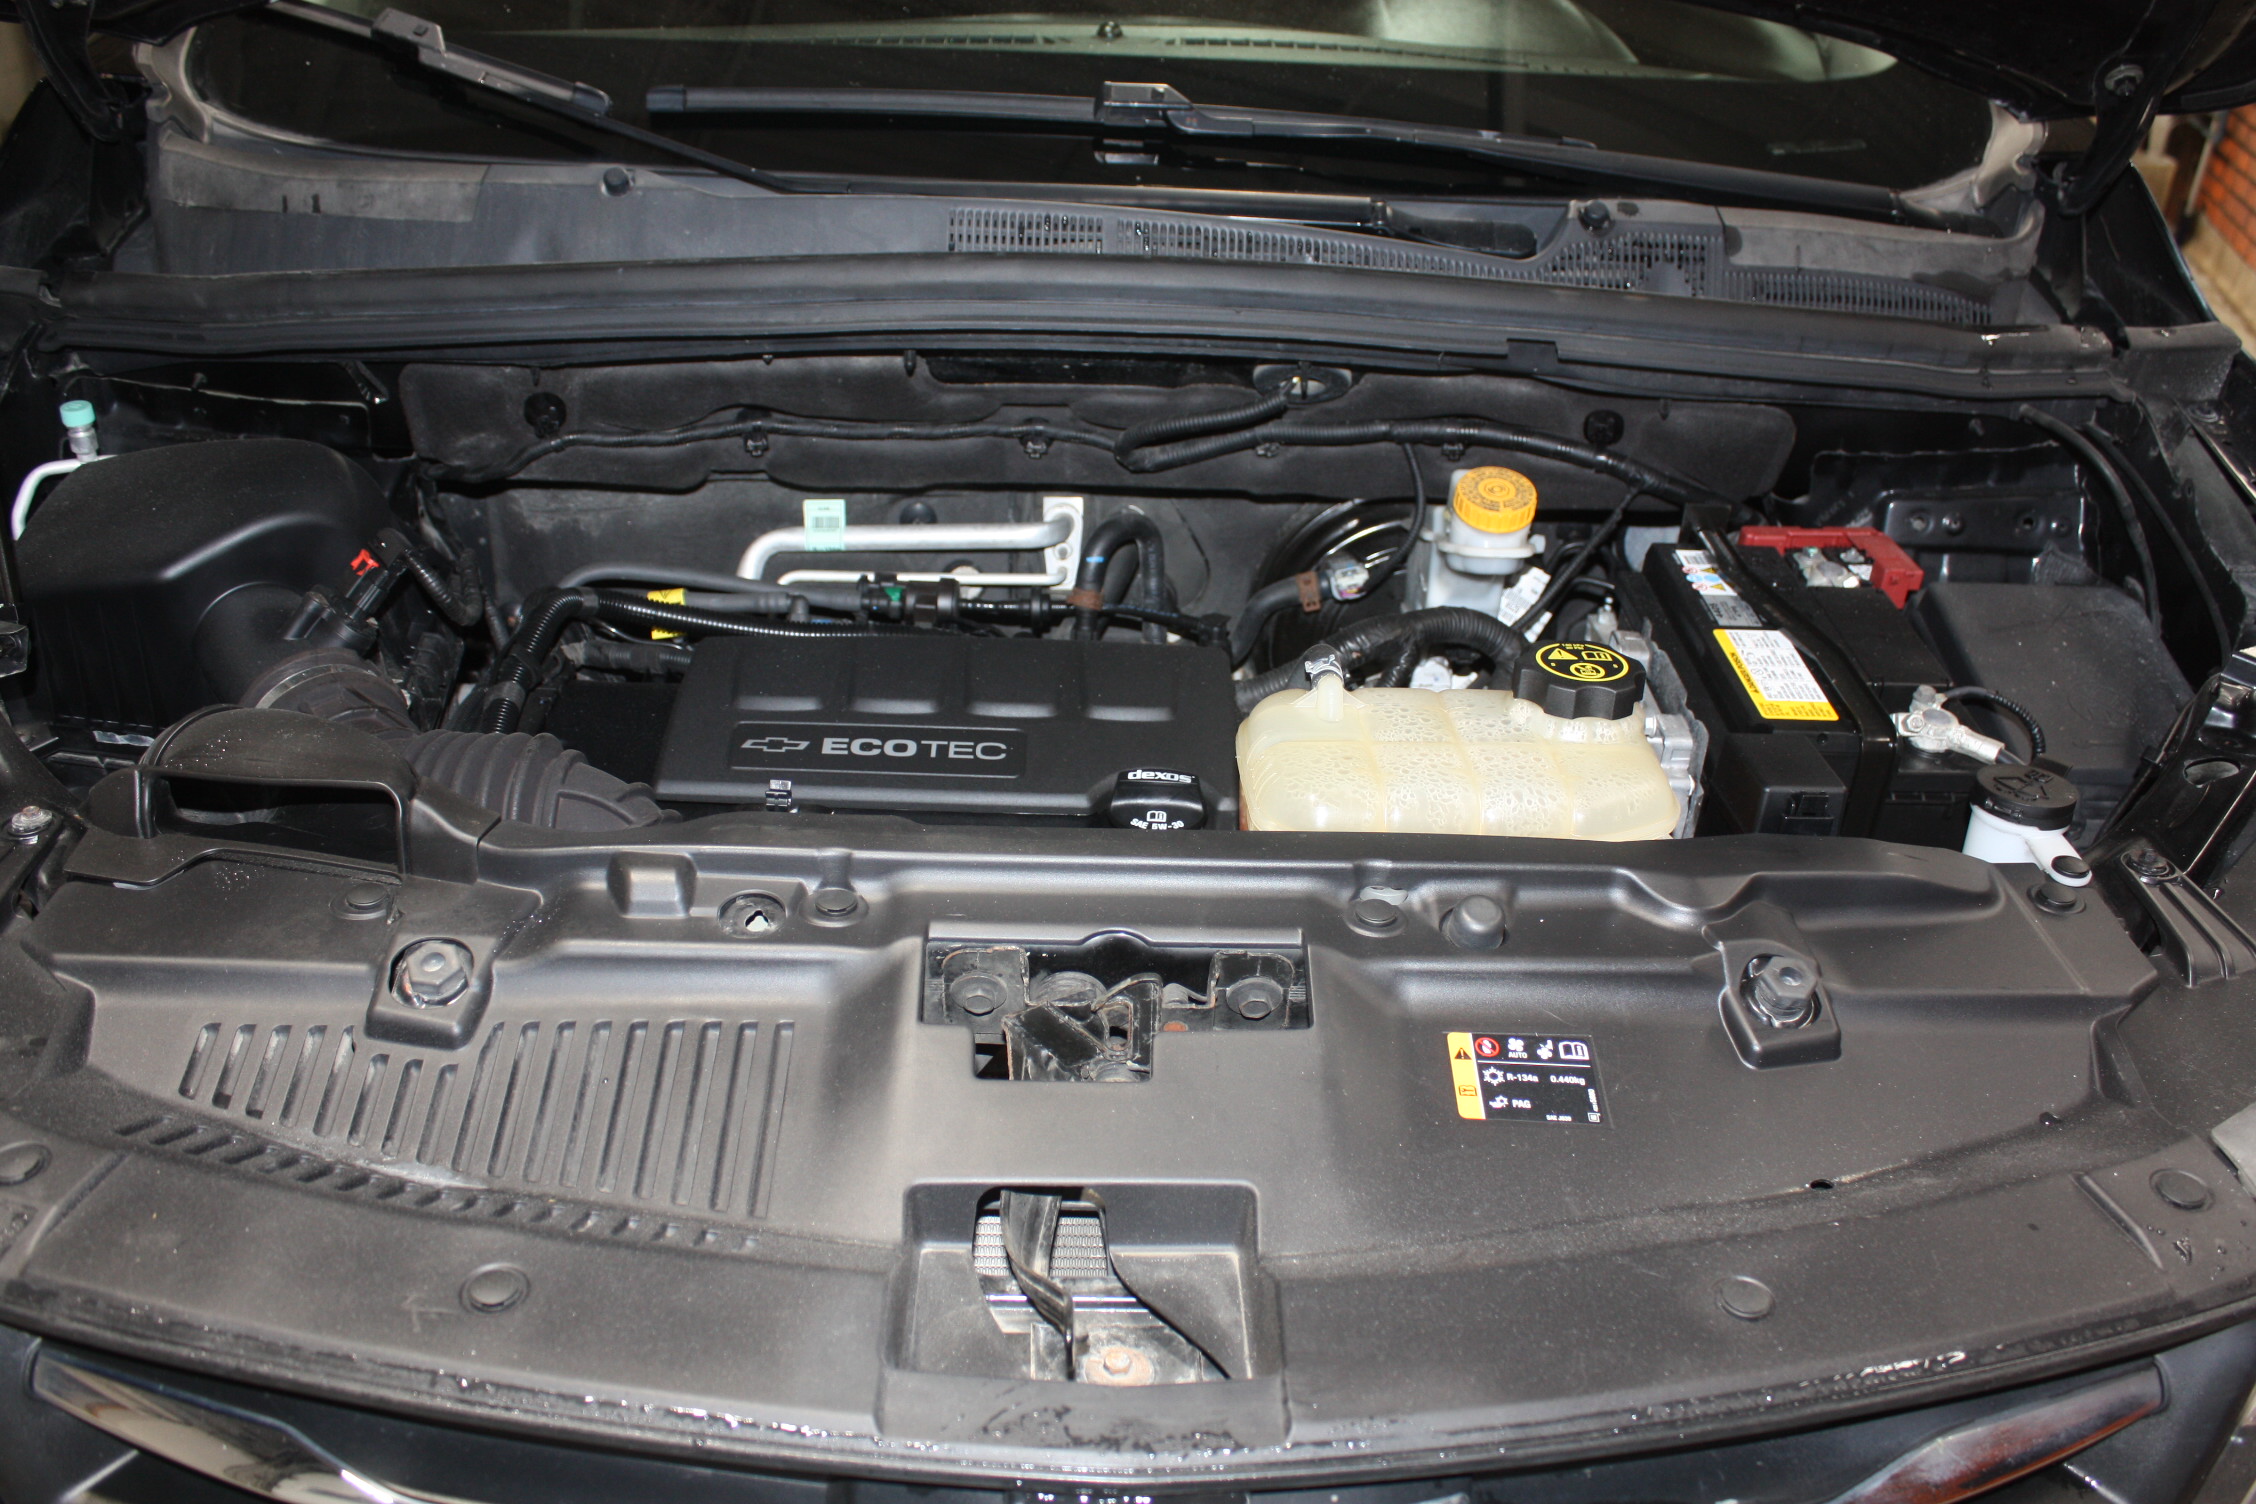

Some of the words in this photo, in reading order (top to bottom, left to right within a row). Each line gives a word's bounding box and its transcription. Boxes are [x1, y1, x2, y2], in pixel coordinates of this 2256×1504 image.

[821, 737, 1007, 761] ECOTEC
[1128, 769, 1192, 784] dexos
[1130, 818, 1149, 830] SAE
[1151, 820, 1185, 830] 5W-30
[1508, 1051, 1528, 1059] AUTO
[1506, 1072, 1539, 1083] R-134a
[1512, 1098, 1532, 1109] PAG
